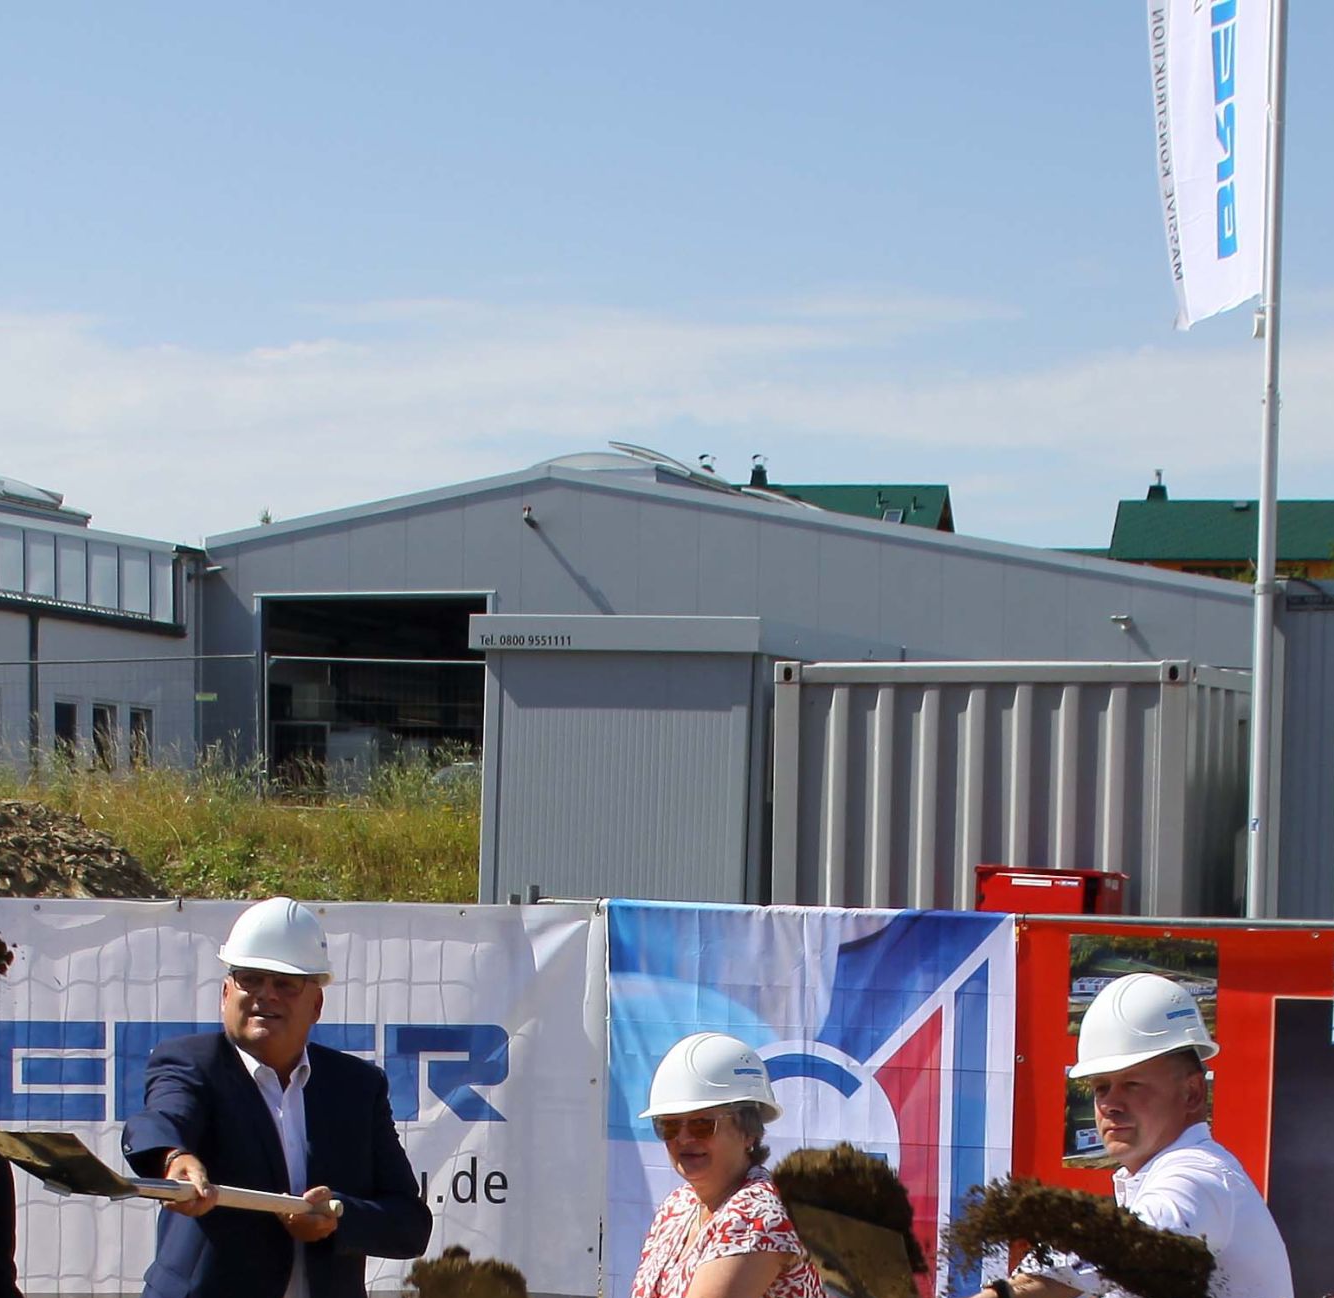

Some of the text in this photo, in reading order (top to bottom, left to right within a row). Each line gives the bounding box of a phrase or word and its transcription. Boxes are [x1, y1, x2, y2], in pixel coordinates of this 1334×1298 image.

[480, 634, 571, 647] Tel. 0800 9551111
